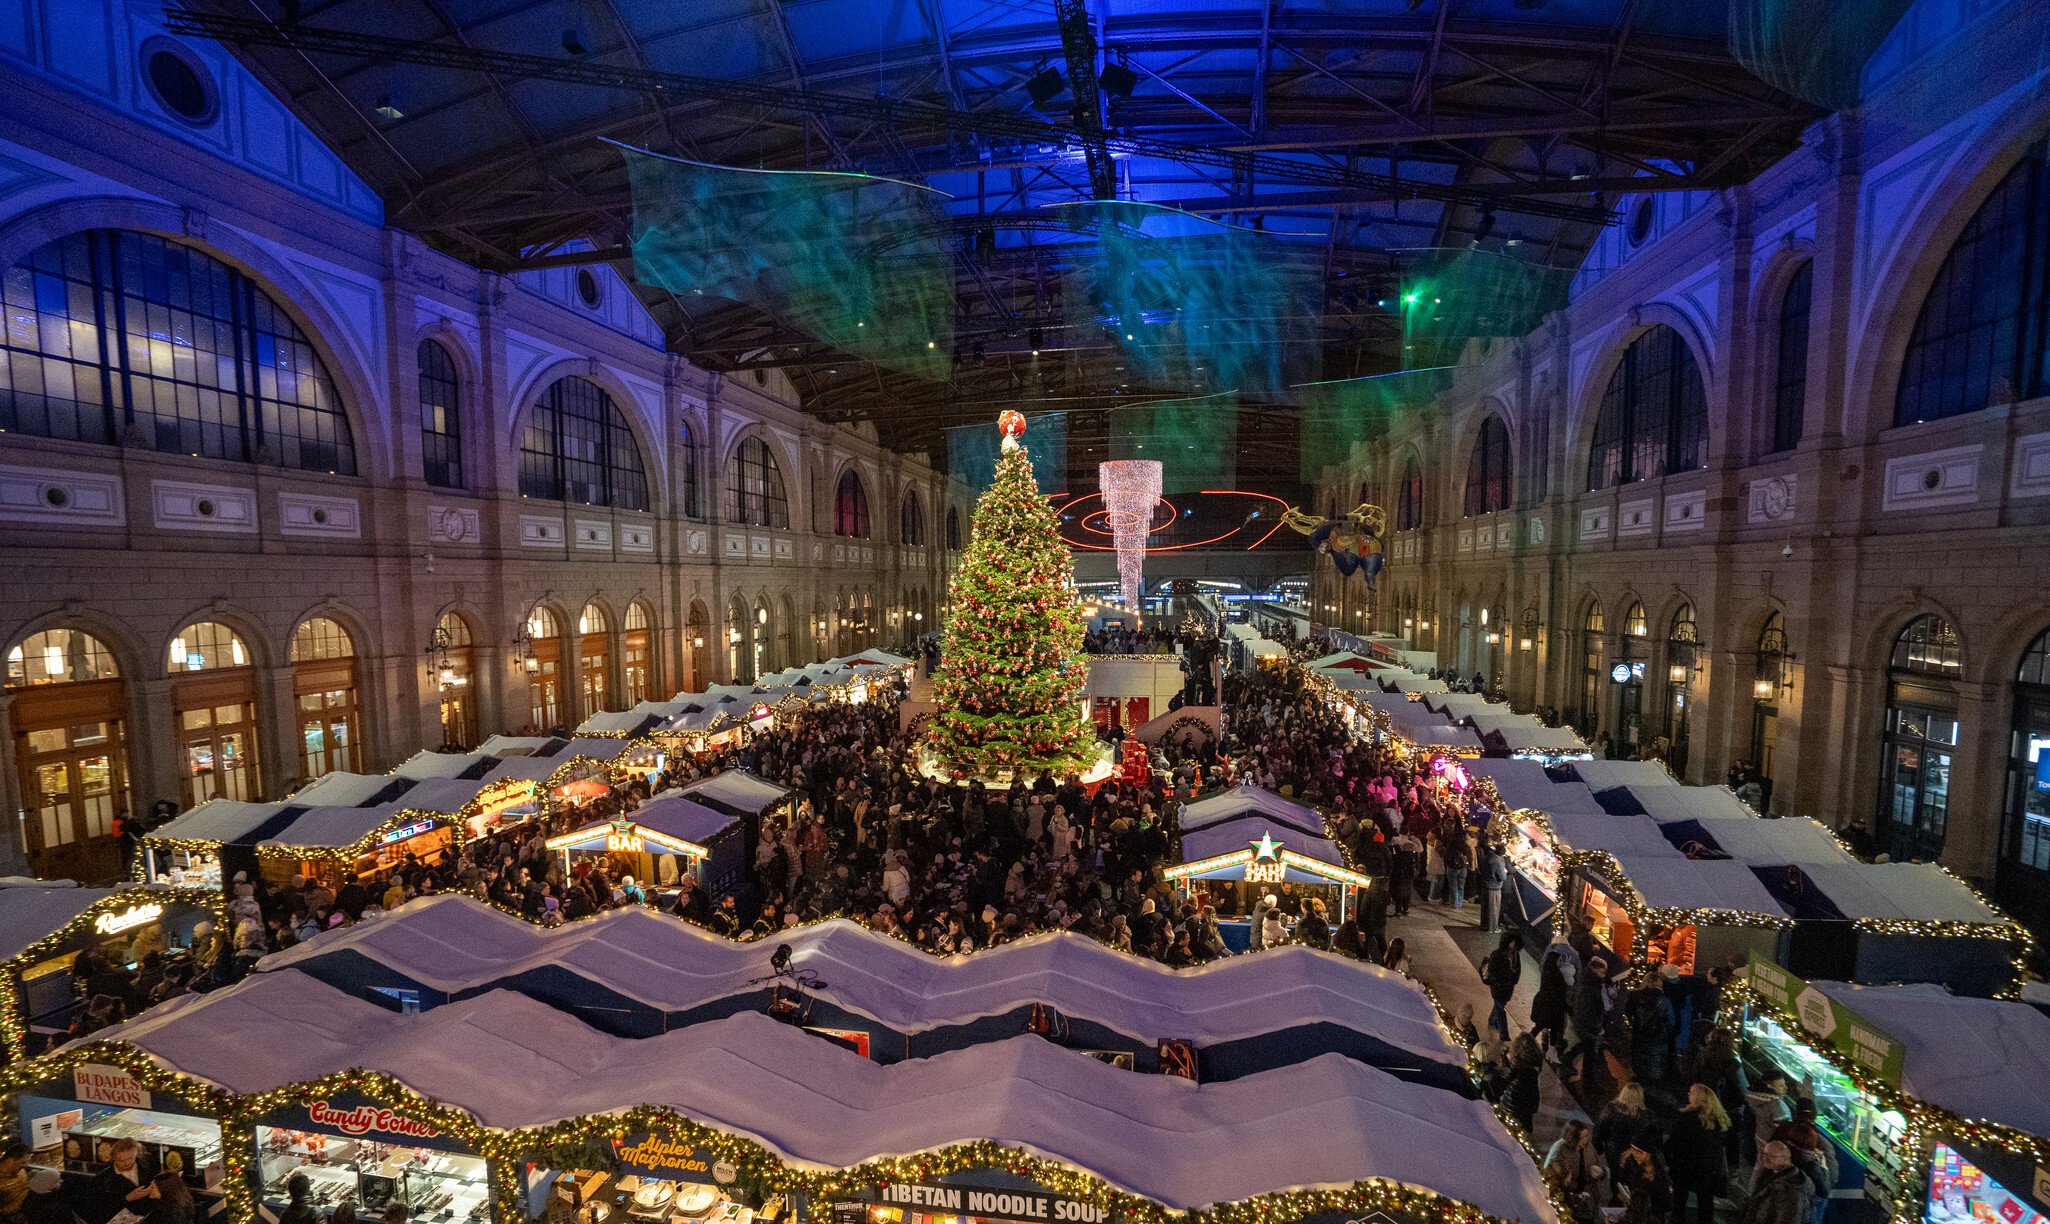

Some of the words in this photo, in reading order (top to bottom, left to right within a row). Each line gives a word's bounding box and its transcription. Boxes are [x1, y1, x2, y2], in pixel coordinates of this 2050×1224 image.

[608, 835, 643, 852] BAR
[77, 1072, 147, 1091] BUDAPES
[309, 1101, 373, 1133] Candy
[638, 1133, 694, 1157] Älpler
[619, 1147, 708, 1172] Magronen
[968, 1191, 1048, 1218] NOODLE
